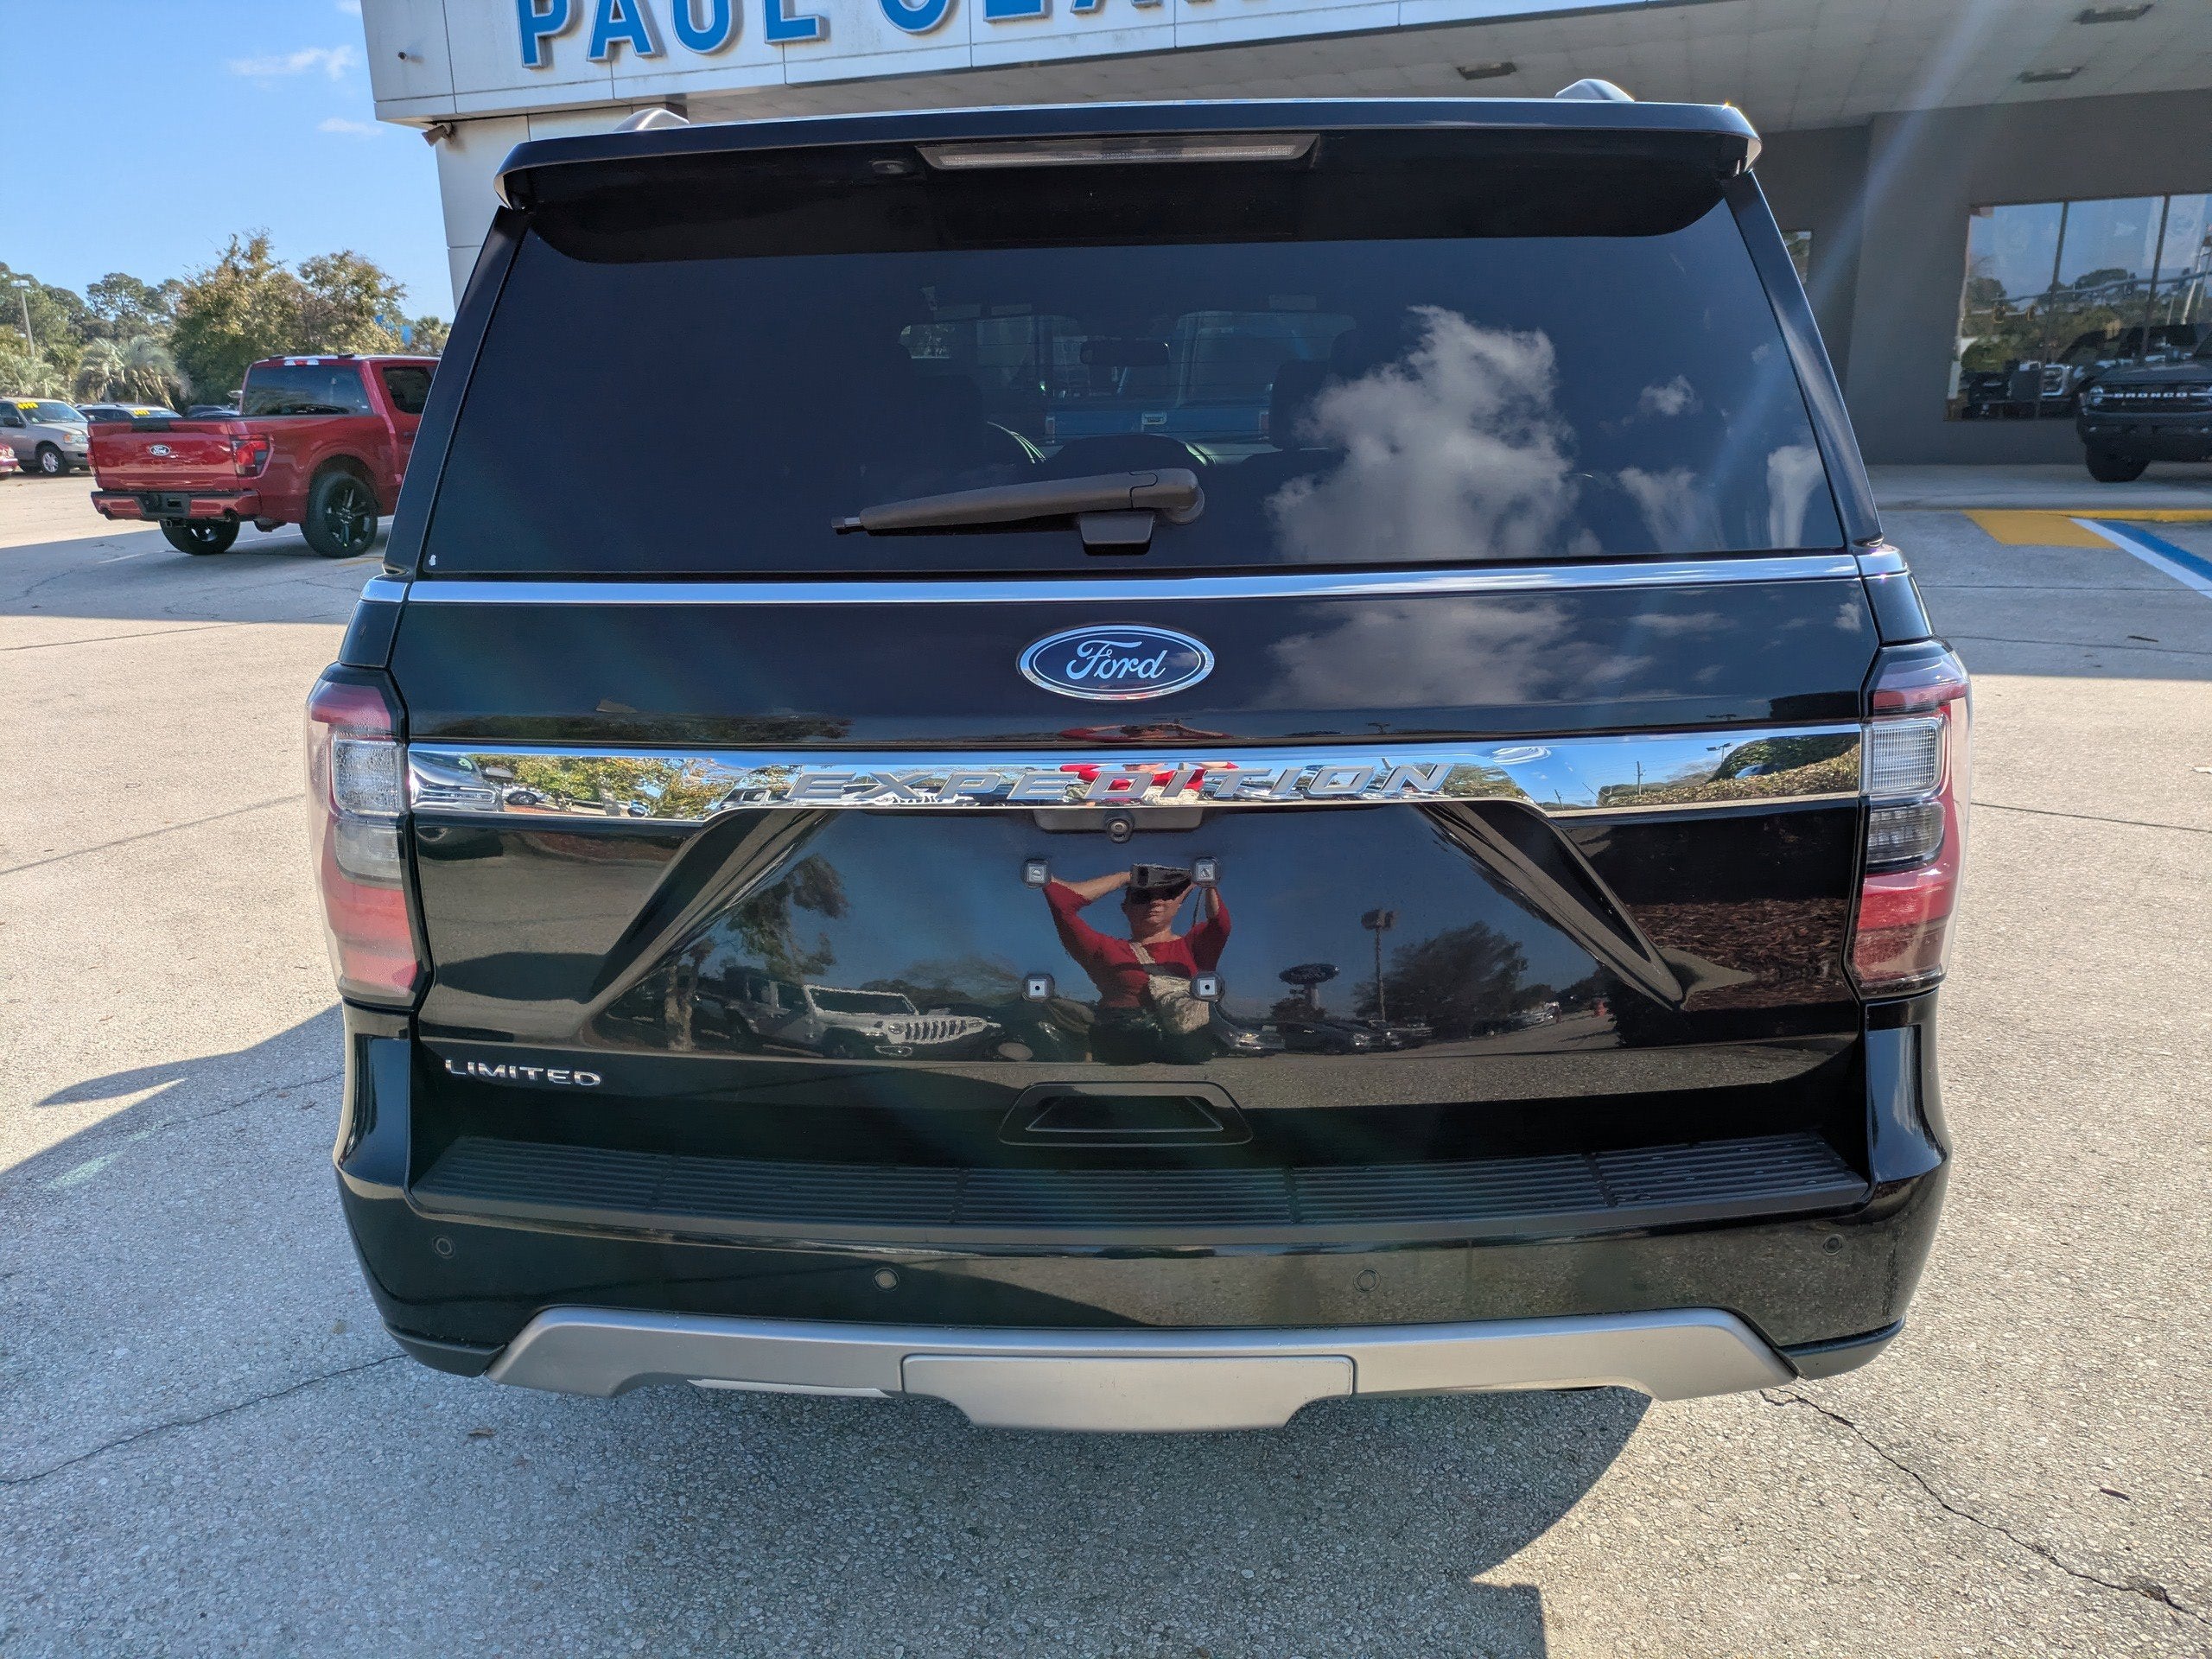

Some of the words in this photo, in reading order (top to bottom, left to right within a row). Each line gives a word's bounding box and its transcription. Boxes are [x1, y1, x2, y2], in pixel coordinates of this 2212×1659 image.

[517, 0, 825, 68] PAUL
[1065, 639, 1168, 680] Ford
[785, 763, 1456, 801] EXPEDITION
[444, 1058, 602, 1087] LIMITED
